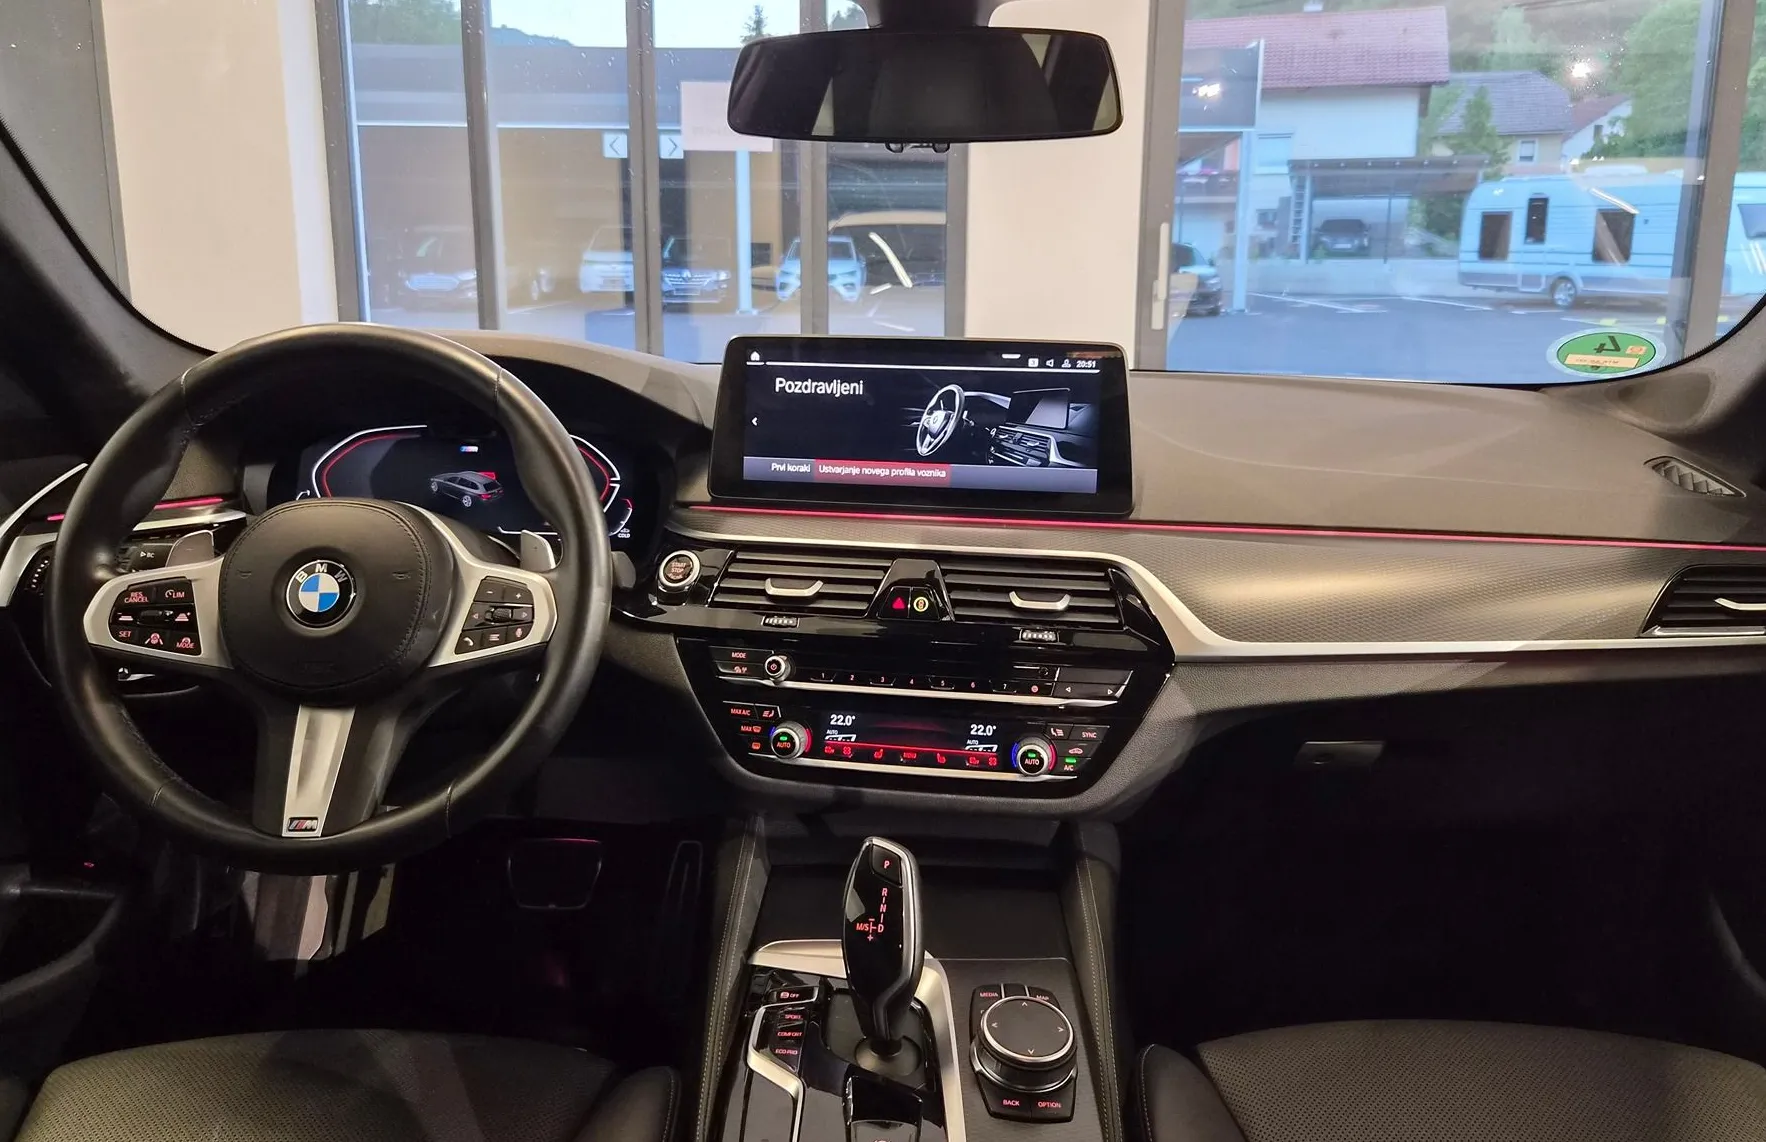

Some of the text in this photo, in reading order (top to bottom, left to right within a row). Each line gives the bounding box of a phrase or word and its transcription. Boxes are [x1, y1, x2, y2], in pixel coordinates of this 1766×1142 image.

[1076, 360, 1096, 368] 20:51
[775, 377, 864, 398] Pozdravljeni
[771, 463, 811, 473] Prvi koraki
[818, 465, 946, 478] Ustvarjanje novega profila voznika
[295, 563, 348, 583] BMW
[124, 596, 149, 604] CANCEL
[118, 630, 132, 638] SET
[731, 651, 747, 659] MODE
[1081, 731, 1097, 739] SYNC
[776, 741, 791, 749] AUTO
[1024, 758, 1040, 766] AUTO
[882, 888, 888, 896] R
[880, 904, 887, 912] N
[856, 923, 884, 932] M/S D
[1037, 1101, 1062, 1109] OPTION
